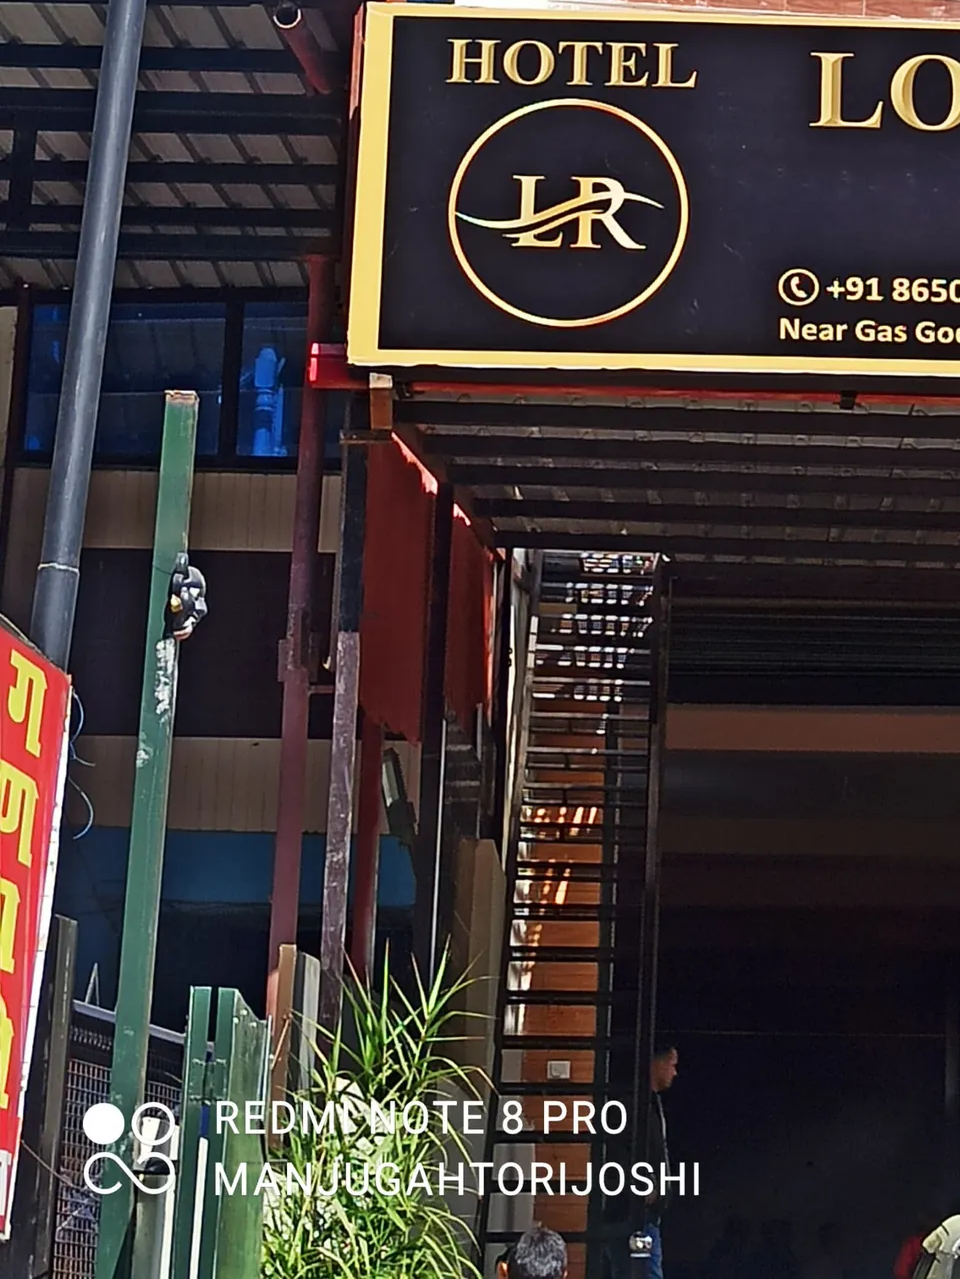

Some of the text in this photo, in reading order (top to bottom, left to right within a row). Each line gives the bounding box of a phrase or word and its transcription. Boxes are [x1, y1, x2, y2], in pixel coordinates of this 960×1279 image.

[446, 38, 698, 89] HOTEL
[511, 174, 647, 251] LR
[826, 276, 884, 302] +91
[779, 317, 848, 342] Near
[854, 319, 908, 344] Gas
